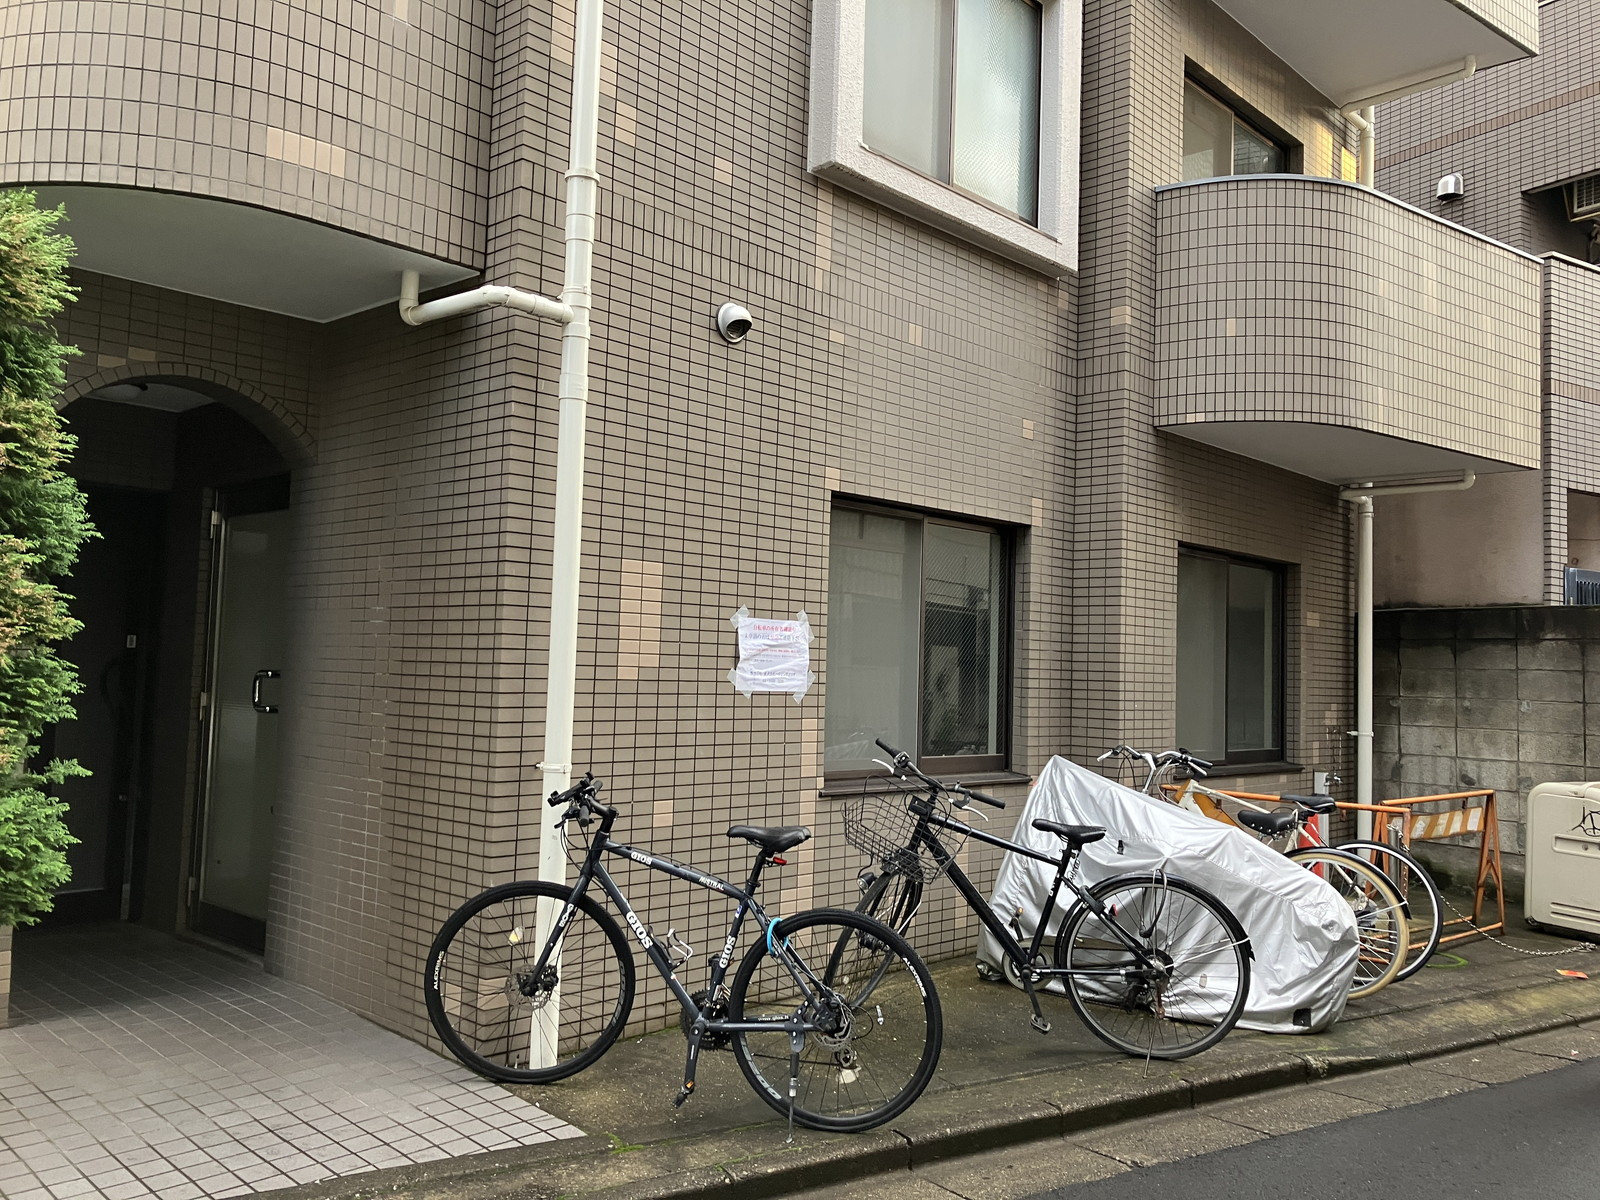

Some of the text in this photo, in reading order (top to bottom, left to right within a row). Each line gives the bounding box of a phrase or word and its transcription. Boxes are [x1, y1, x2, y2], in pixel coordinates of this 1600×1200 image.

[630, 851, 653, 866] GIOS
[699, 876, 725, 891] MISTRAL
[626, 911, 653, 949] GIOS
[719, 935, 736, 969] GIOS
[433, 950, 445, 991] ALEXRIMS
[902, 956, 927, 998] ALEXRIMS
